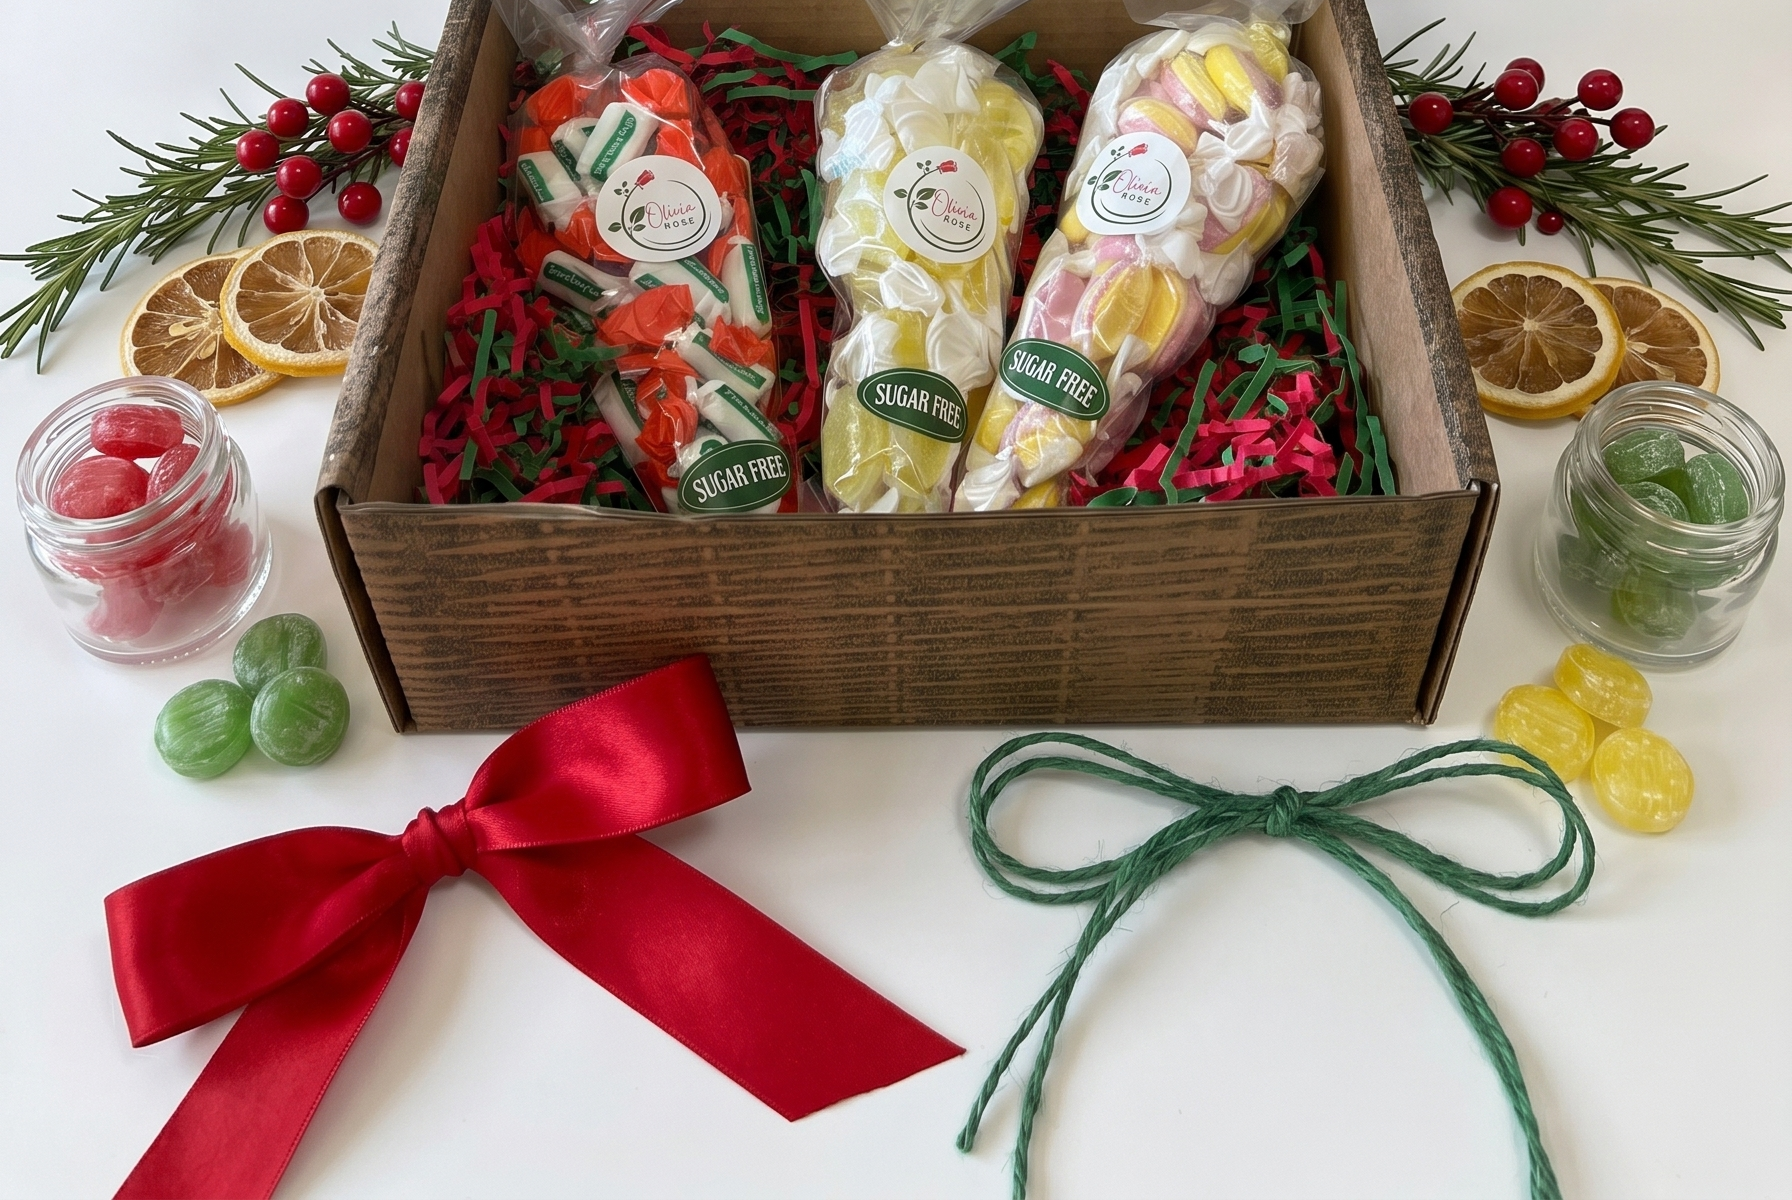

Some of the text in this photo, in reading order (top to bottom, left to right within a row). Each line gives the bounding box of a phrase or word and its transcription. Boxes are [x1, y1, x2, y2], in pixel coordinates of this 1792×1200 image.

[1120, 192, 1151, 206] ROSE
[645, 201, 696, 229] Olivia
[664, 217, 695, 230] ROSE
[943, 214, 972, 232] ROSE
[1008, 349, 1098, 409] SUGAR FREE
[874, 383, 962, 430] SUGAR FREE
[692, 455, 786, 504] SUGAR FREE
